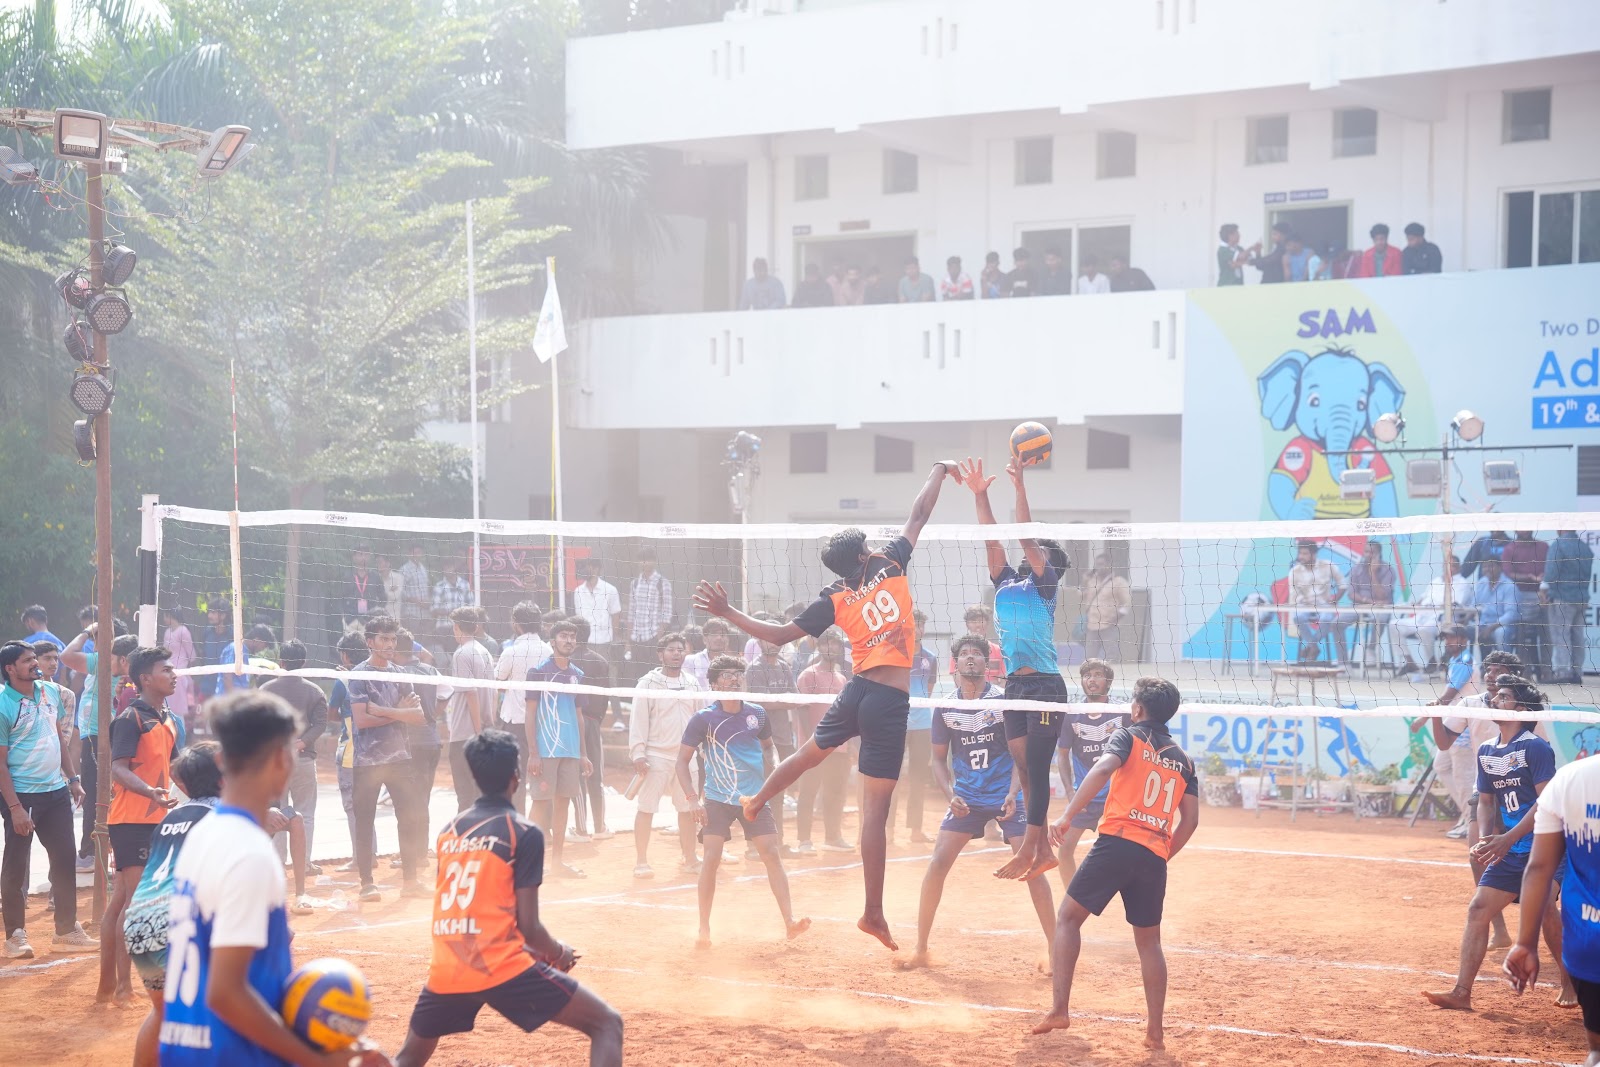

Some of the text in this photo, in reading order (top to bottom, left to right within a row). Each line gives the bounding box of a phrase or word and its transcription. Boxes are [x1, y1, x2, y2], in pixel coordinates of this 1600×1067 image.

[1297, 306, 1377, 339] SAM
[1540, 317, 1600, 337] Two D
[1533, 346, 1599, 389] Ad
[1540, 399, 1578, 424] 19th
[861, 589, 901, 632] 09
[969, 748, 989, 770] 27
[1143, 769, 1177, 814] 01
[1503, 790, 1520, 813] 10
[441, 860, 481, 911] 35
